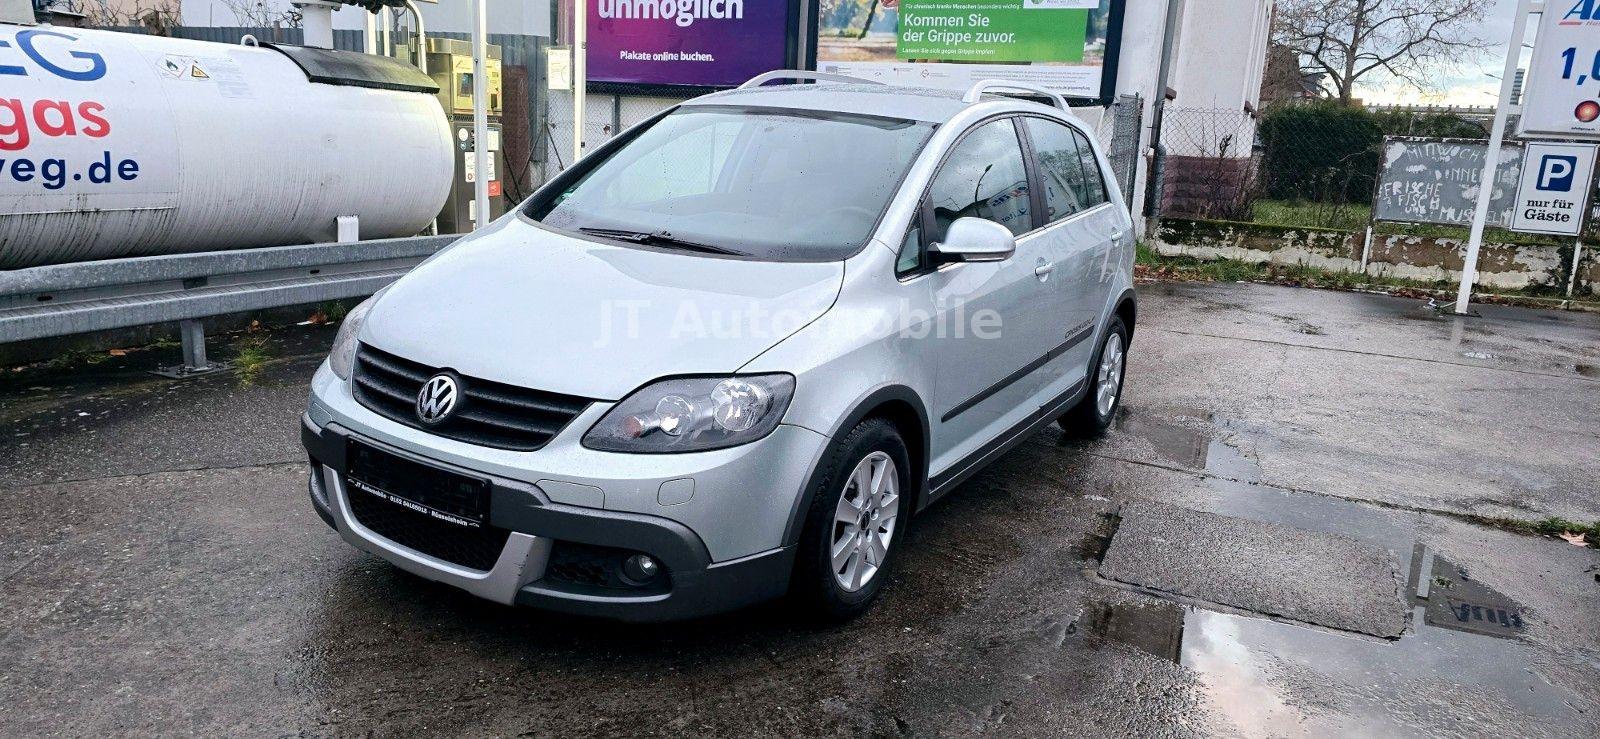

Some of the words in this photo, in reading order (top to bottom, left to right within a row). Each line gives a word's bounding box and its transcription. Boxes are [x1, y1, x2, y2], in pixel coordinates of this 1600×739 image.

[904, 13, 964, 27] Kommen
[968, 13, 990, 27] Sie
[902, 28, 925, 42] der
[928, 29, 971, 45] Grippe
[975, 32, 1016, 44] zuvor.
[620, 50, 651, 60] Plakate
[652, 52, 679, 61] online
[680, 51, 715, 61] buchen.
[1541, 158, 1572, 188] P
[1526, 199, 1550, 208] nur
[1551, 198, 1574, 210] für
[1524, 208, 1570, 223] Gäste
